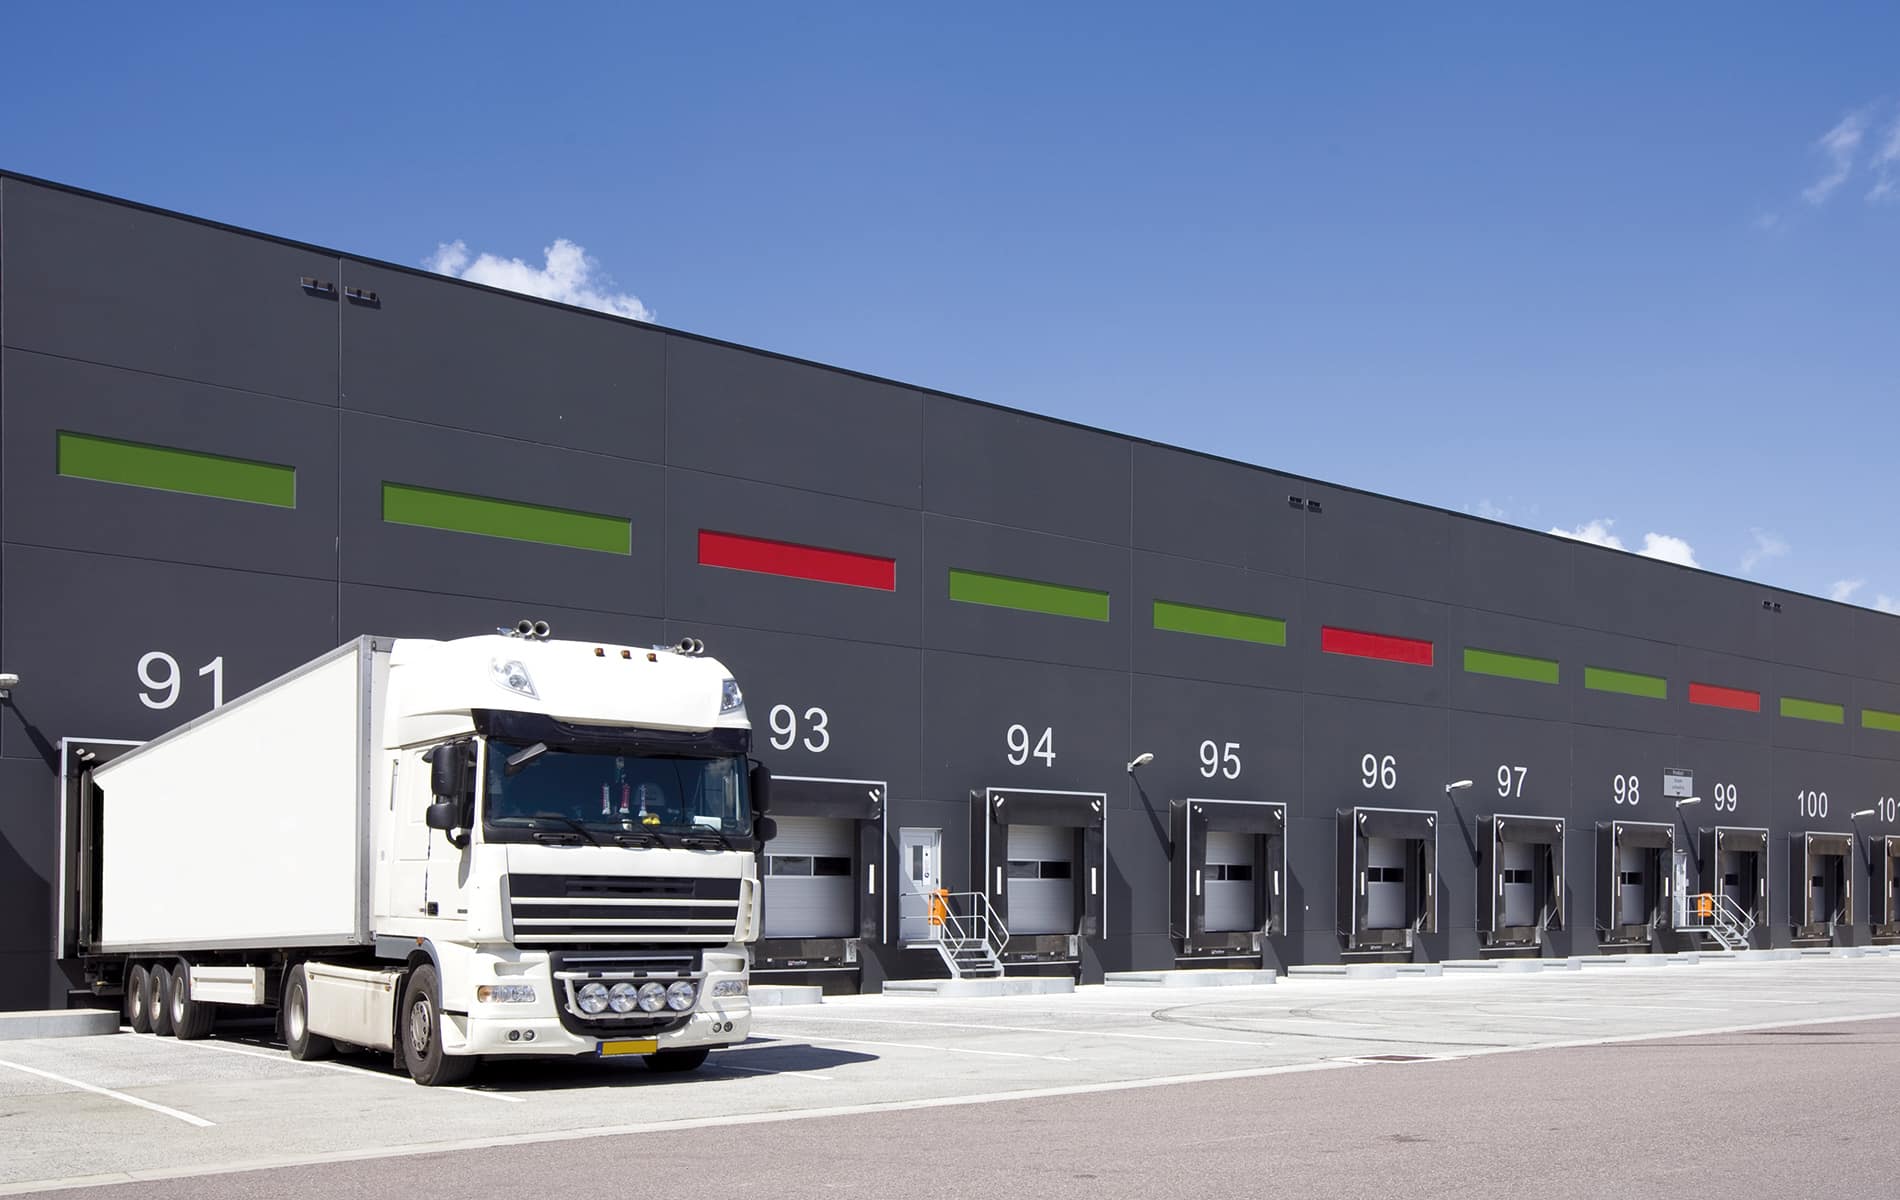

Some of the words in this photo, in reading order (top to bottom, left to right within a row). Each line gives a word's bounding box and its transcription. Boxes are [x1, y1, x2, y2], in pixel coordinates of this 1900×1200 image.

[138, 652, 223, 709] 91
[770, 705, 829, 752] 93
[1007, 725, 1055, 767] 94
[1200, 740, 1240, 779] 95
[1362, 754, 1396, 789] 96
[1498, 765, 1527, 797] 97
[1614, 775, 1639, 805] 98
[1715, 783, 1736, 811] 99
[1797, 791, 1827, 817] 100
[1878, 797, 1900, 822] 10
